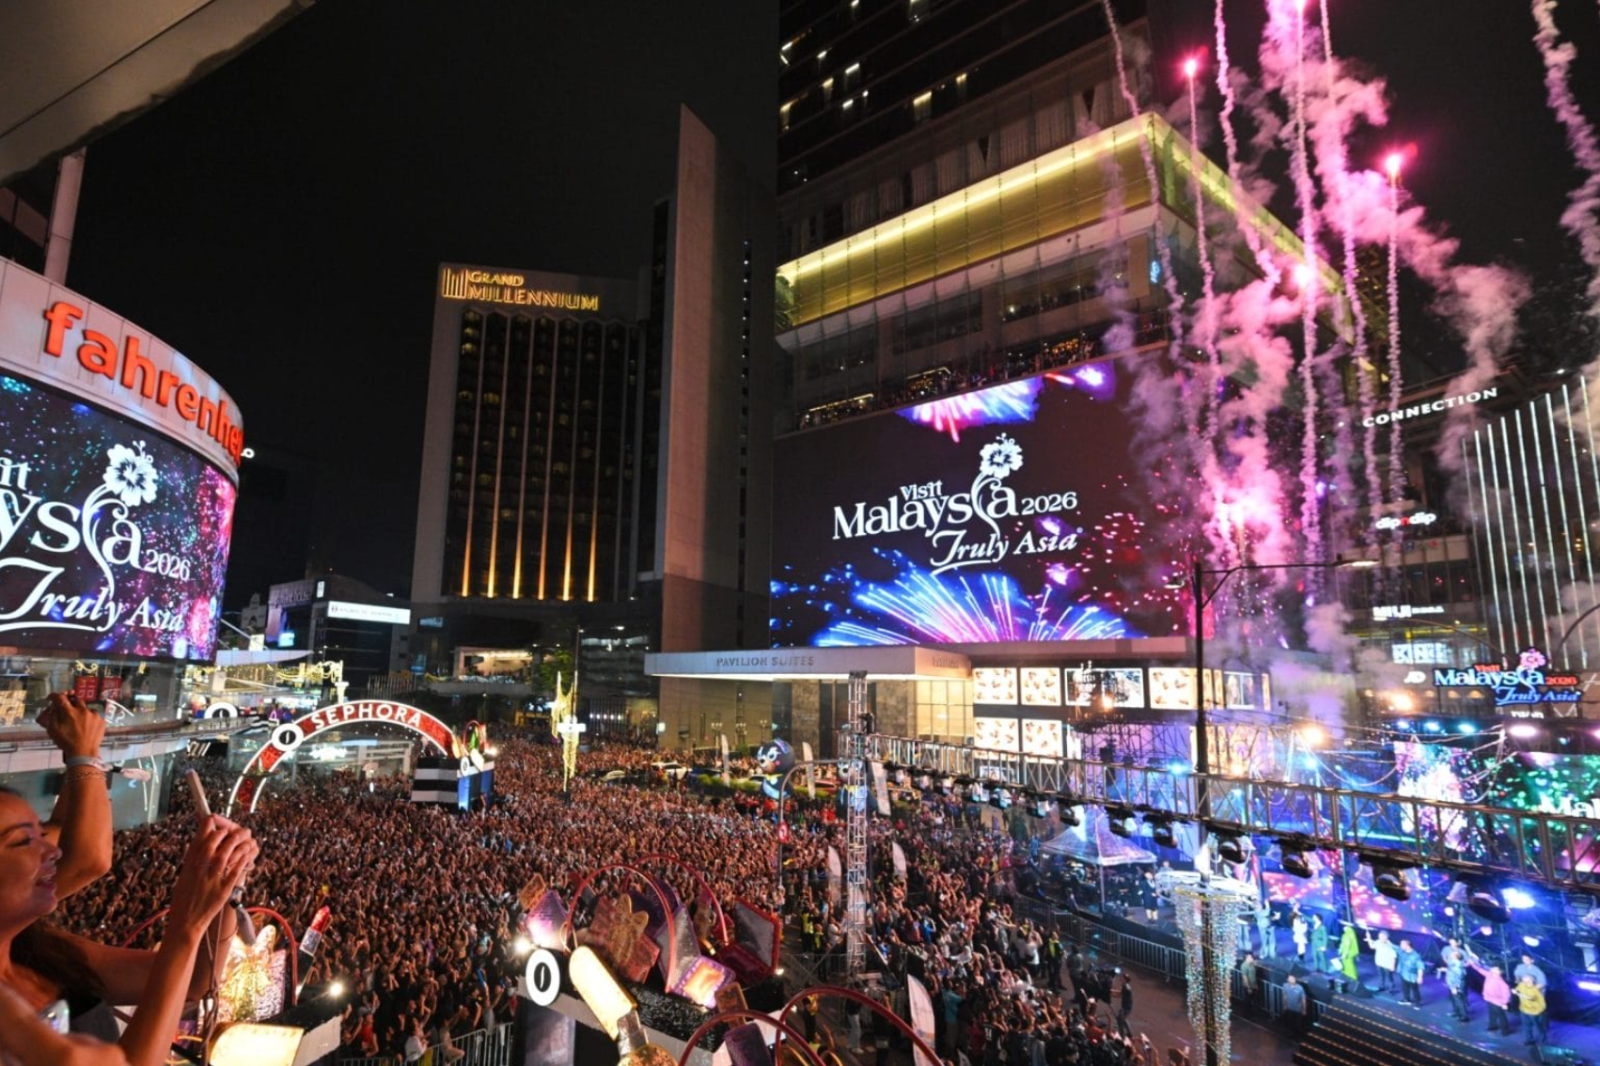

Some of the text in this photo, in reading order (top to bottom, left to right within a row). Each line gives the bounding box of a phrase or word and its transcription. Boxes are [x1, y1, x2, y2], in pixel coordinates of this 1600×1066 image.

[468, 271, 524, 286] GRAND
[468, 285, 599, 311] MILLENNIUM
[1362, 387, 1498, 428] CONNECTION
[900, 480, 943, 501] Visit
[832, 473, 1078, 540] Malaysia 2026
[930, 529, 1078, 569] Truly Asia
[142, 549, 192, 582] 2026
[124, 596, 185, 632] Asia
[716, 656, 815, 667] PAVILION SUITES
[1434, 664, 1578, 689] Malaysia 2026
[1495, 686, 1579, 704] Truly Asia
[311, 702, 422, 730] SEPHORA
